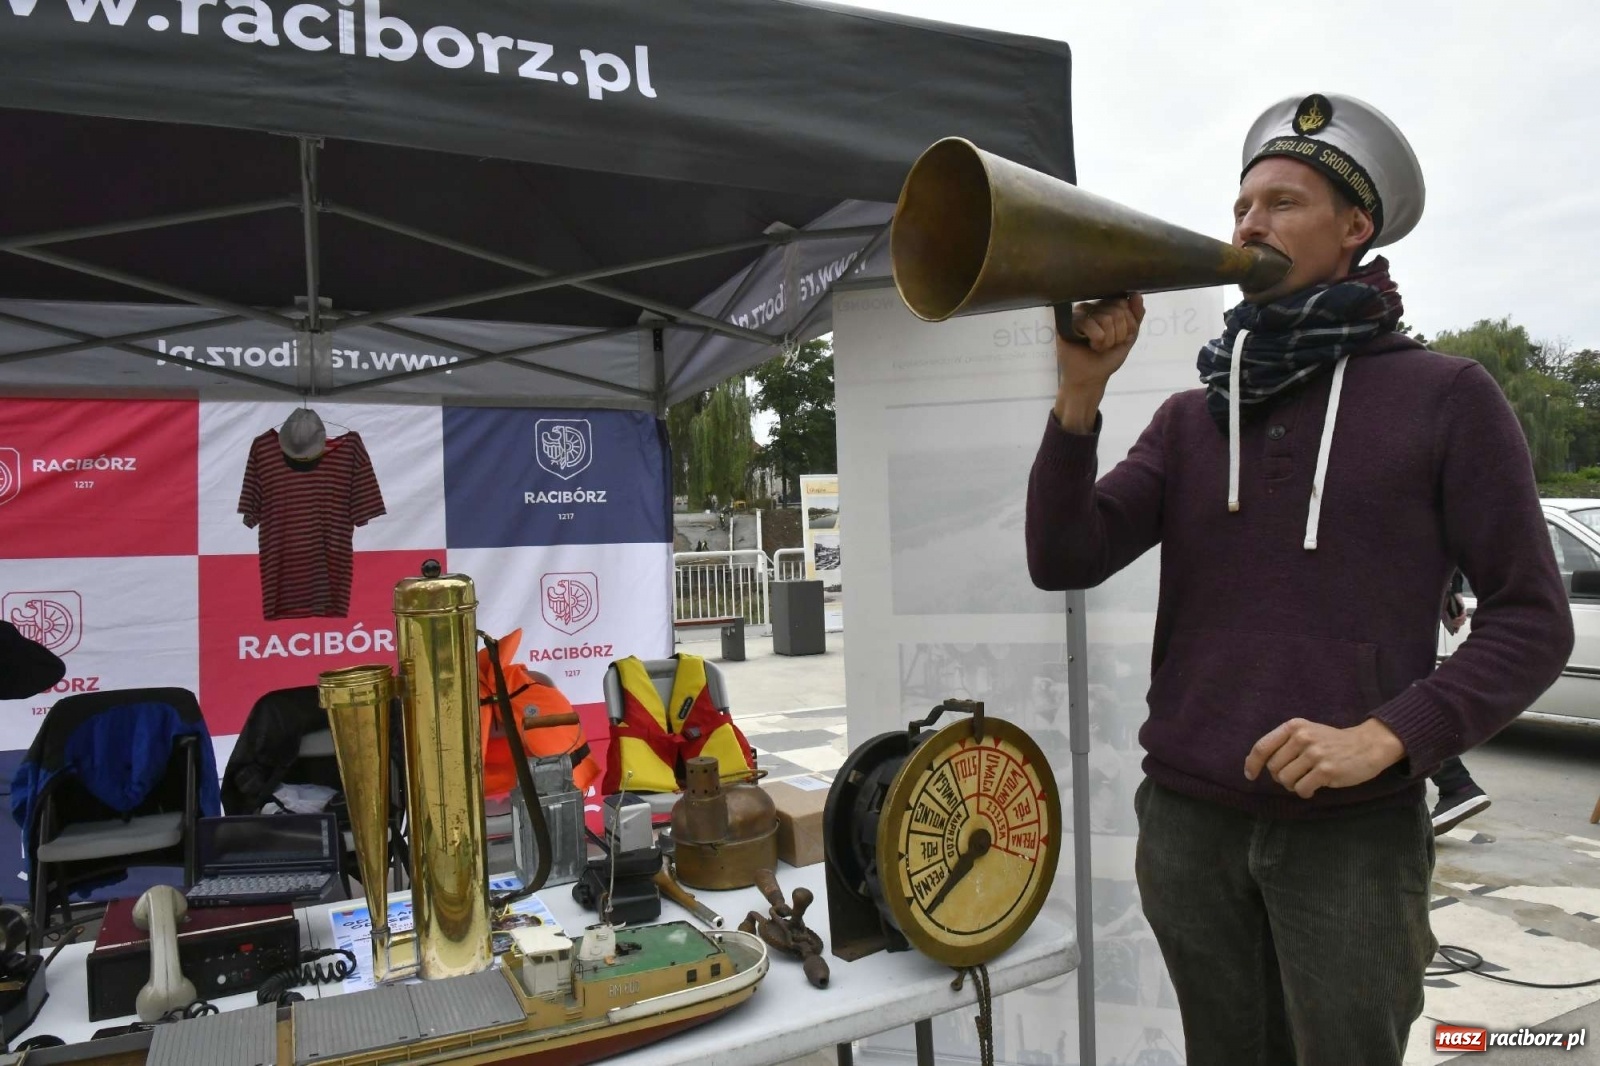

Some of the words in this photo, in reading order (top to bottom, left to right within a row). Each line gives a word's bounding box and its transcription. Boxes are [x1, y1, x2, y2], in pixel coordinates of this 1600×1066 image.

[32, 454, 137, 472] RACIBÓRZ
[74, 481, 94, 489] 1217
[524, 486, 607, 503] RACIBÓRZ
[238, 621, 397, 660] RACIBÓR
[529, 642, 613, 662] RACIBÓRZ
[955, 755, 977, 784] STÓJ
[982, 753, 1000, 793] UWAGA
[933, 769, 958, 809] UWAGA
[997, 768, 1023, 806] WOLNO
[920, 841, 938, 862] PÓŁ
[1012, 831, 1036, 849] PEŁNA
[914, 866, 945, 900] PEŁNA
